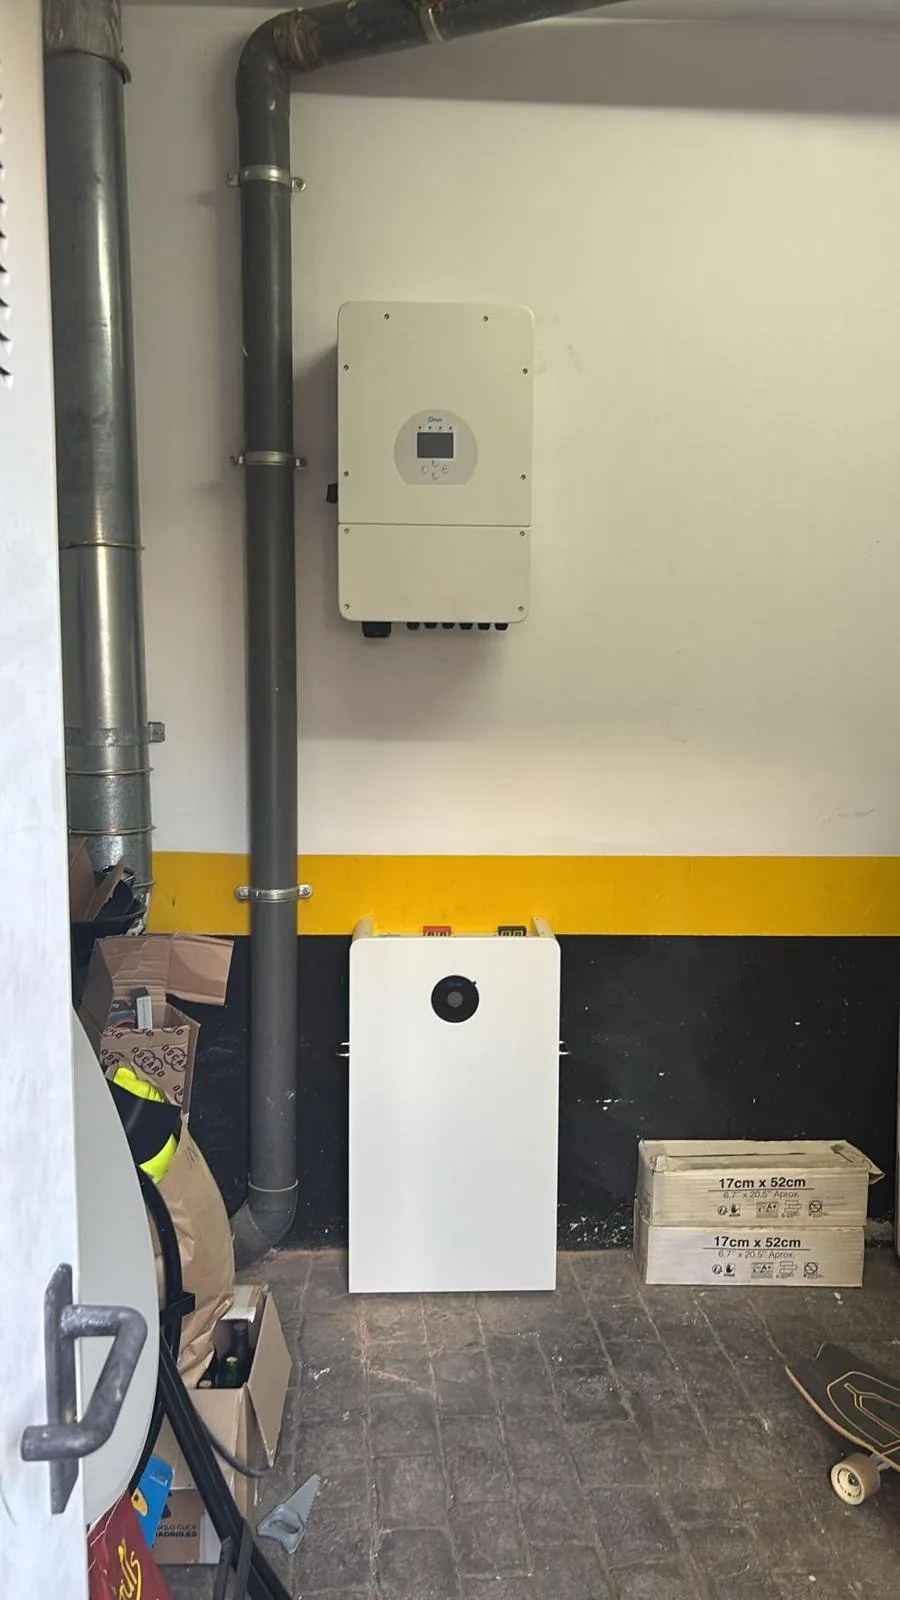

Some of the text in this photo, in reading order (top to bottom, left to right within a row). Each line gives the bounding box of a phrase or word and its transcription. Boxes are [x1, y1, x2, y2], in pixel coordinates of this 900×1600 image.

[131, 1046, 165, 1078] OSCARO
[719, 1177, 806, 1188] 17cm x 52cm
[714, 1236, 801, 1248] 17cm x 52cm
